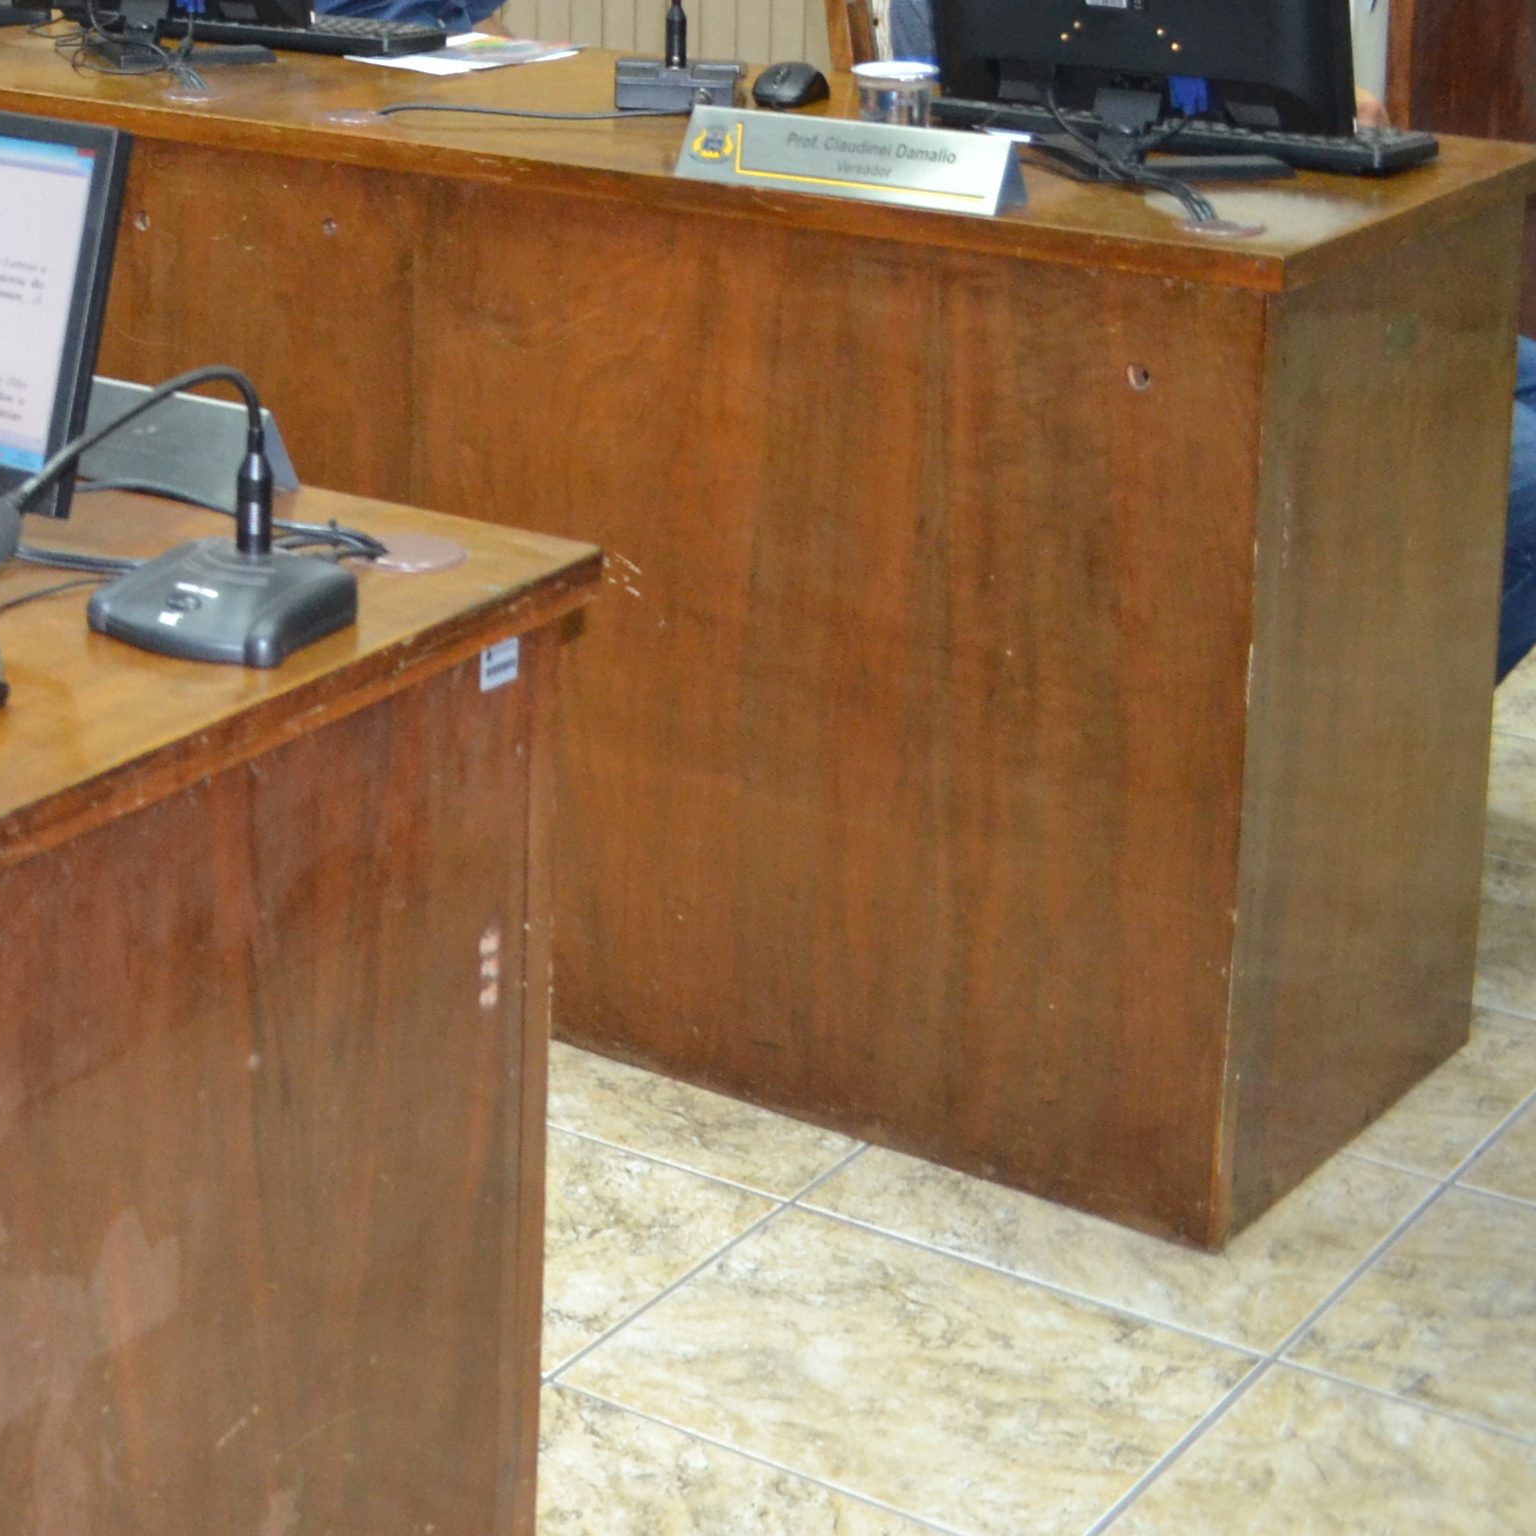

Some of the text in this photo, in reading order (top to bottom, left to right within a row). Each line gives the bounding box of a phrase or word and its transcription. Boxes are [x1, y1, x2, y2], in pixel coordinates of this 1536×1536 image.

[824, 136, 892, 158] Claudinei
[896, 141, 957, 164] Damalio
[837, 160, 892, 178] Vereador
